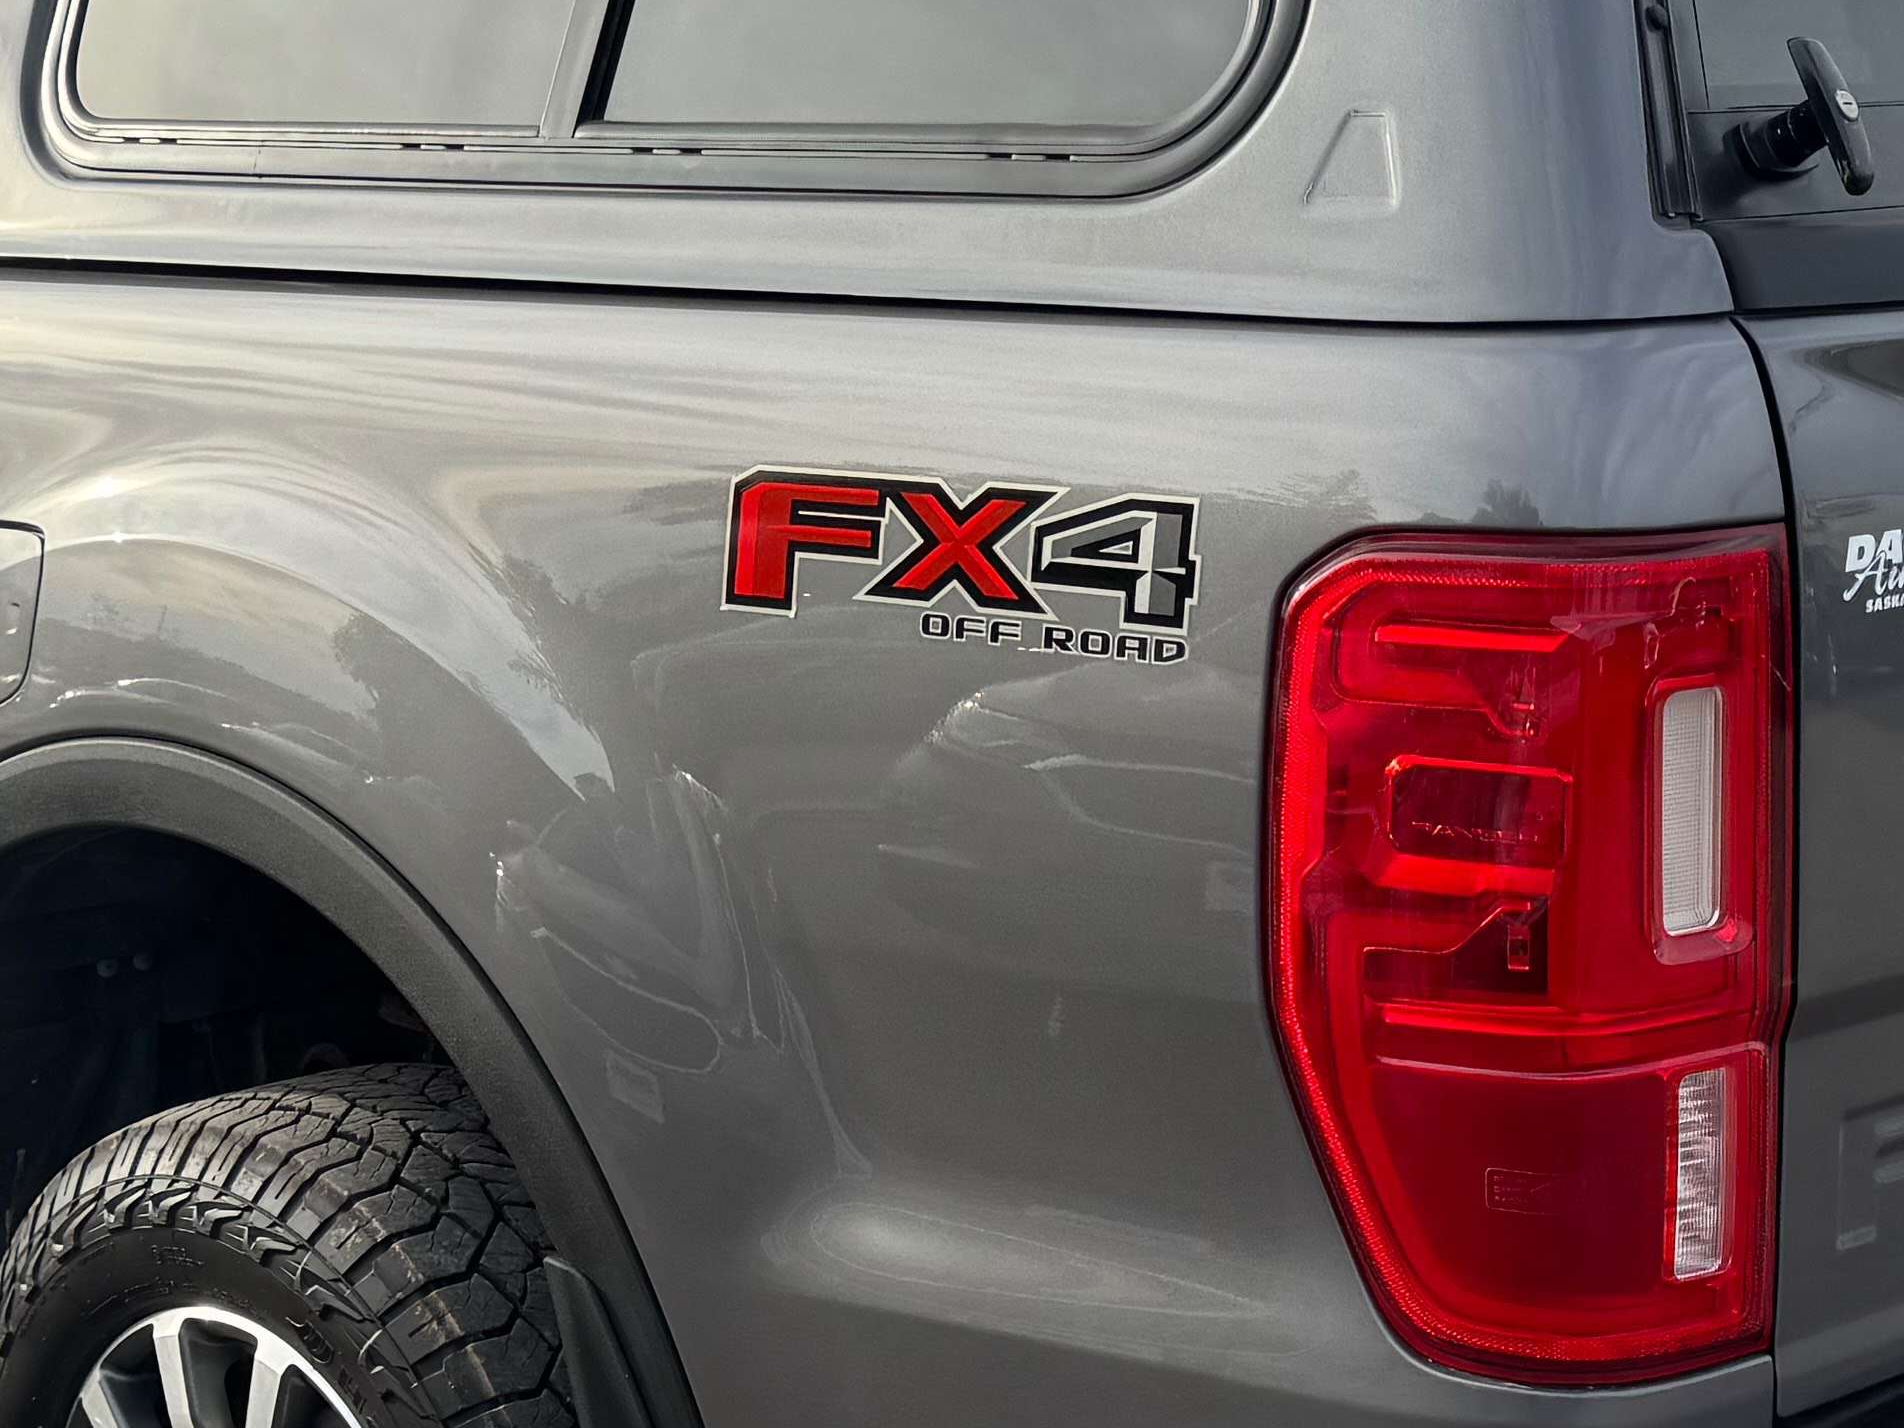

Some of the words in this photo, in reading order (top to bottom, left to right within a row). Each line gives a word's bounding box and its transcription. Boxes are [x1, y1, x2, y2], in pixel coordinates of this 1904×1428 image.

[721, 465, 1202, 636] FX4
[919, 612, 1024, 646] OFF
[1041, 625, 1190, 665] ROAD
